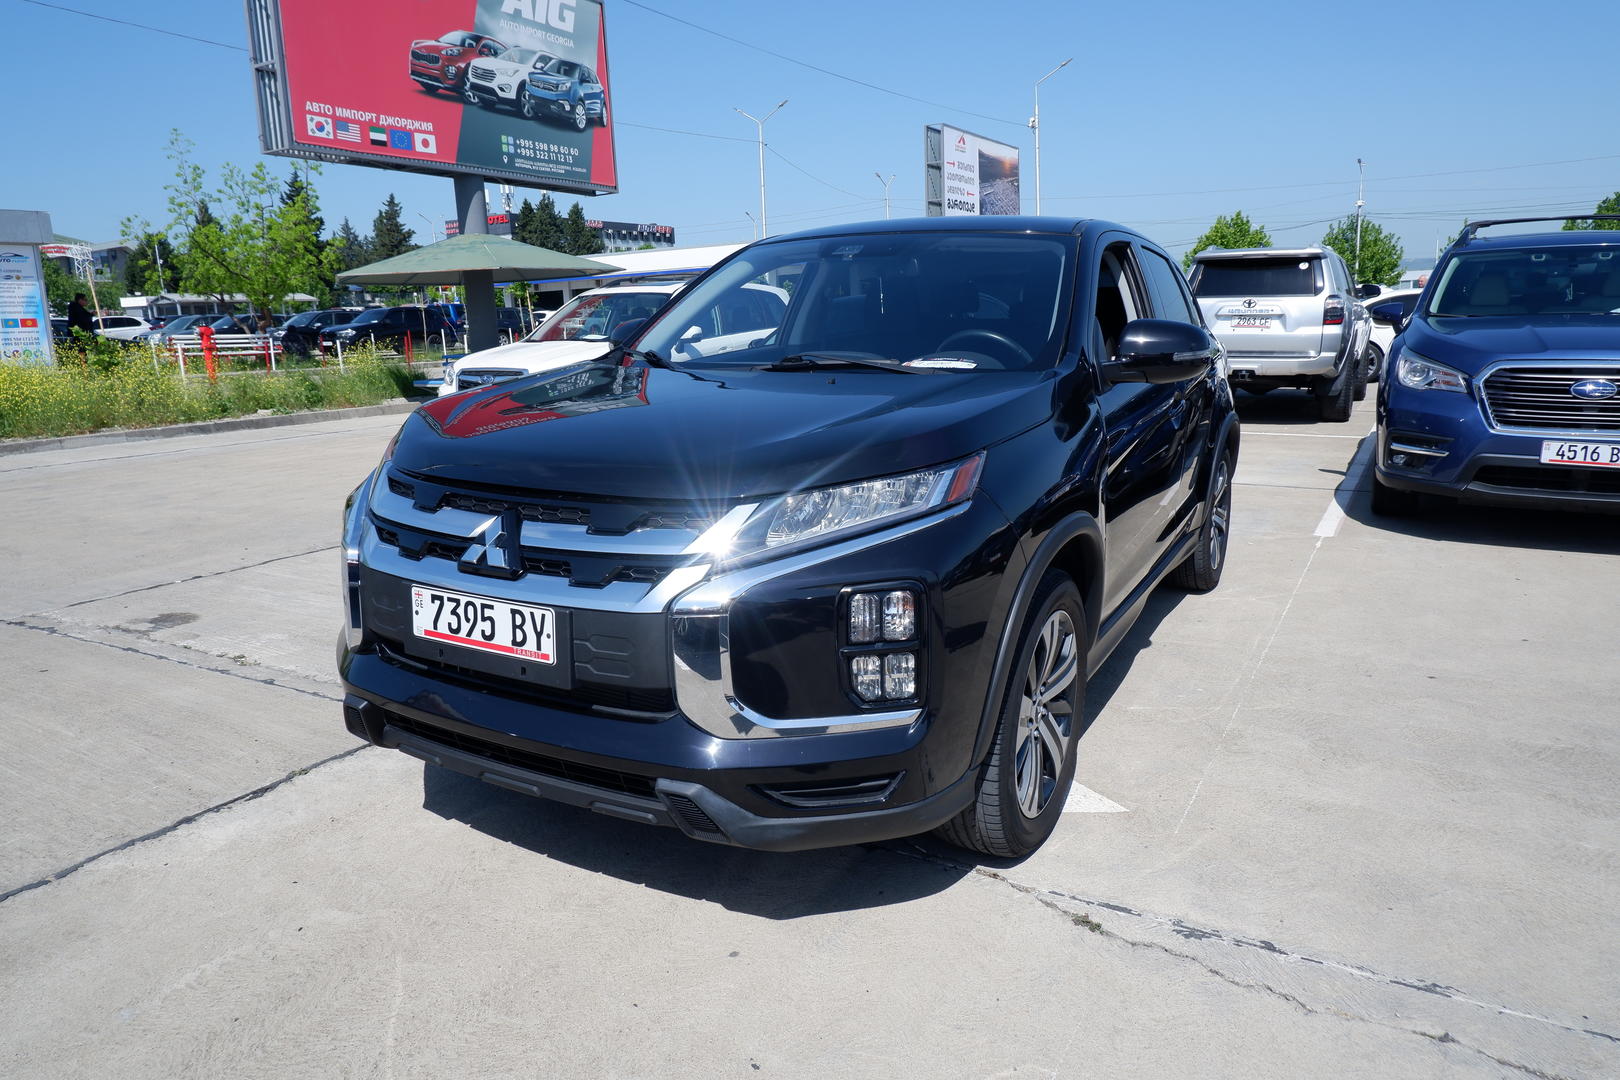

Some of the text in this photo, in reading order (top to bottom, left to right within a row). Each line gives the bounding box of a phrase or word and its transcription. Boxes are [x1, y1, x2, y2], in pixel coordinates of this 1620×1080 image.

[501, 0, 576, 33] AIG
[500, 19, 575, 48] AUTO IMPORT GEORGIA
[305, 100, 434, 132] АВТО ИМПОРТ ДЖОРДЖИЯ
[516, 138, 533, 149] +995
[535, 141, 548, 151] 598
[570, 147, 579, 156] 60
[517, 148, 573, 164] +995 322 11 12 13
[487, 214, 509, 225] OTEL
[1237, 317, 1257, 325] 2963
[1555, 444, 1600, 462] 4516
[414, 599, 424, 609] GE
[430, 593, 546, 651] 7395 BY
[513, 647, 541, 659] TRANSIT
